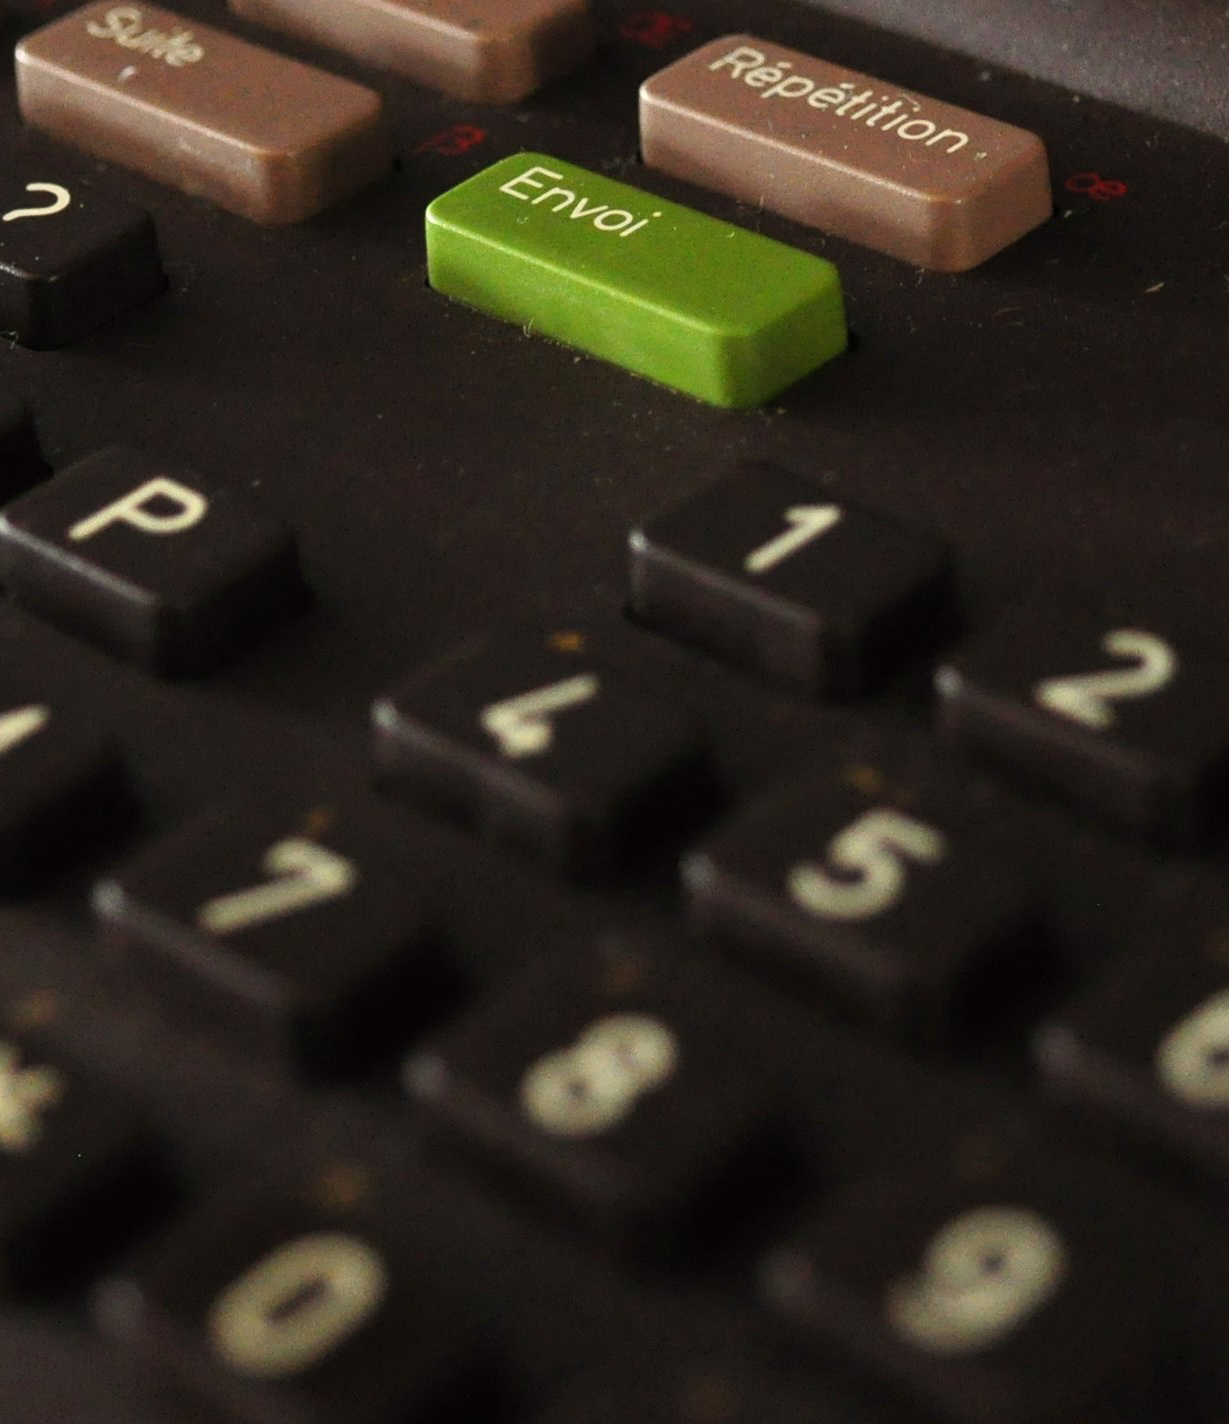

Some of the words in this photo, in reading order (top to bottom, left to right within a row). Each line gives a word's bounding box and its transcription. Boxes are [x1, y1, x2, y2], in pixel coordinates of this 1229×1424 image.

[85, 6, 205, 67] Suite
[707, 45, 970, 155] Répétition
[498, 164, 663, 238] Envoi
[69, 476, 209, 541] P
[745, 504, 842, 574] 1
[1034, 628, 1178, 730] 2
[787, 808, 944, 922] 5
